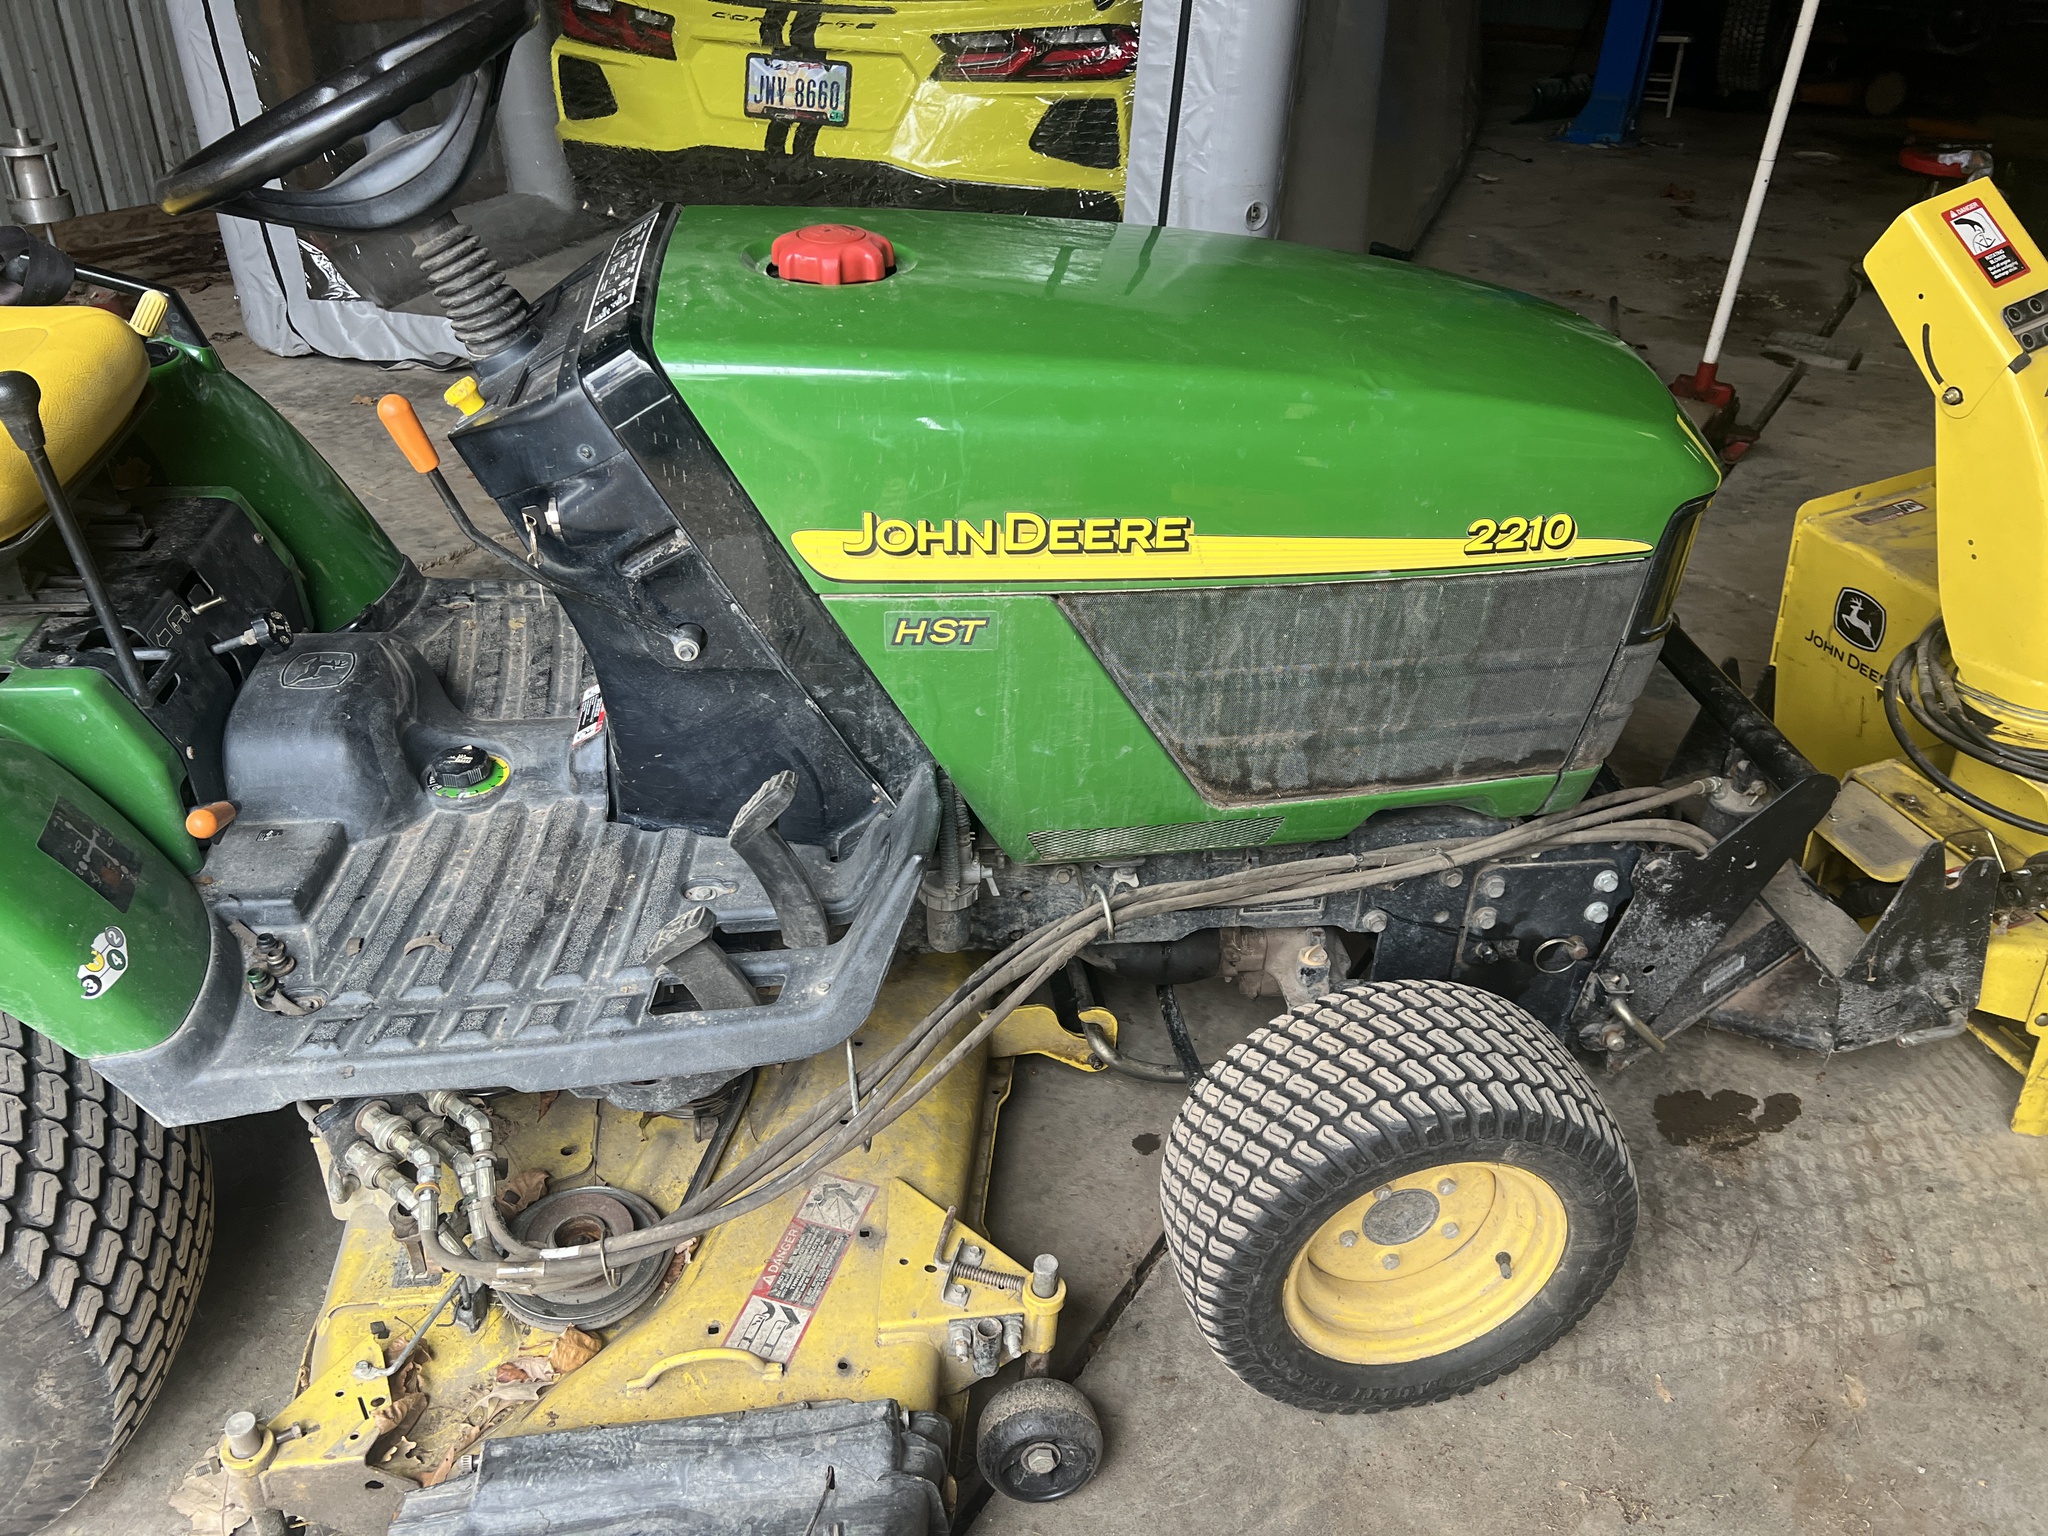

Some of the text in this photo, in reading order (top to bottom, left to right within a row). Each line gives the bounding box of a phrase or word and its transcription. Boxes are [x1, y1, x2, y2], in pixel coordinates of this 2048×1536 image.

[795, 78, 840, 110] 8660
[843, 511, 1194, 556] JOHN DEERE
[1464, 513, 1577, 556] 2210
[890, 617, 991, 646] HST
[1805, 629, 1884, 683] JOHN DEE
[768, 1229, 798, 1273] DANGER
